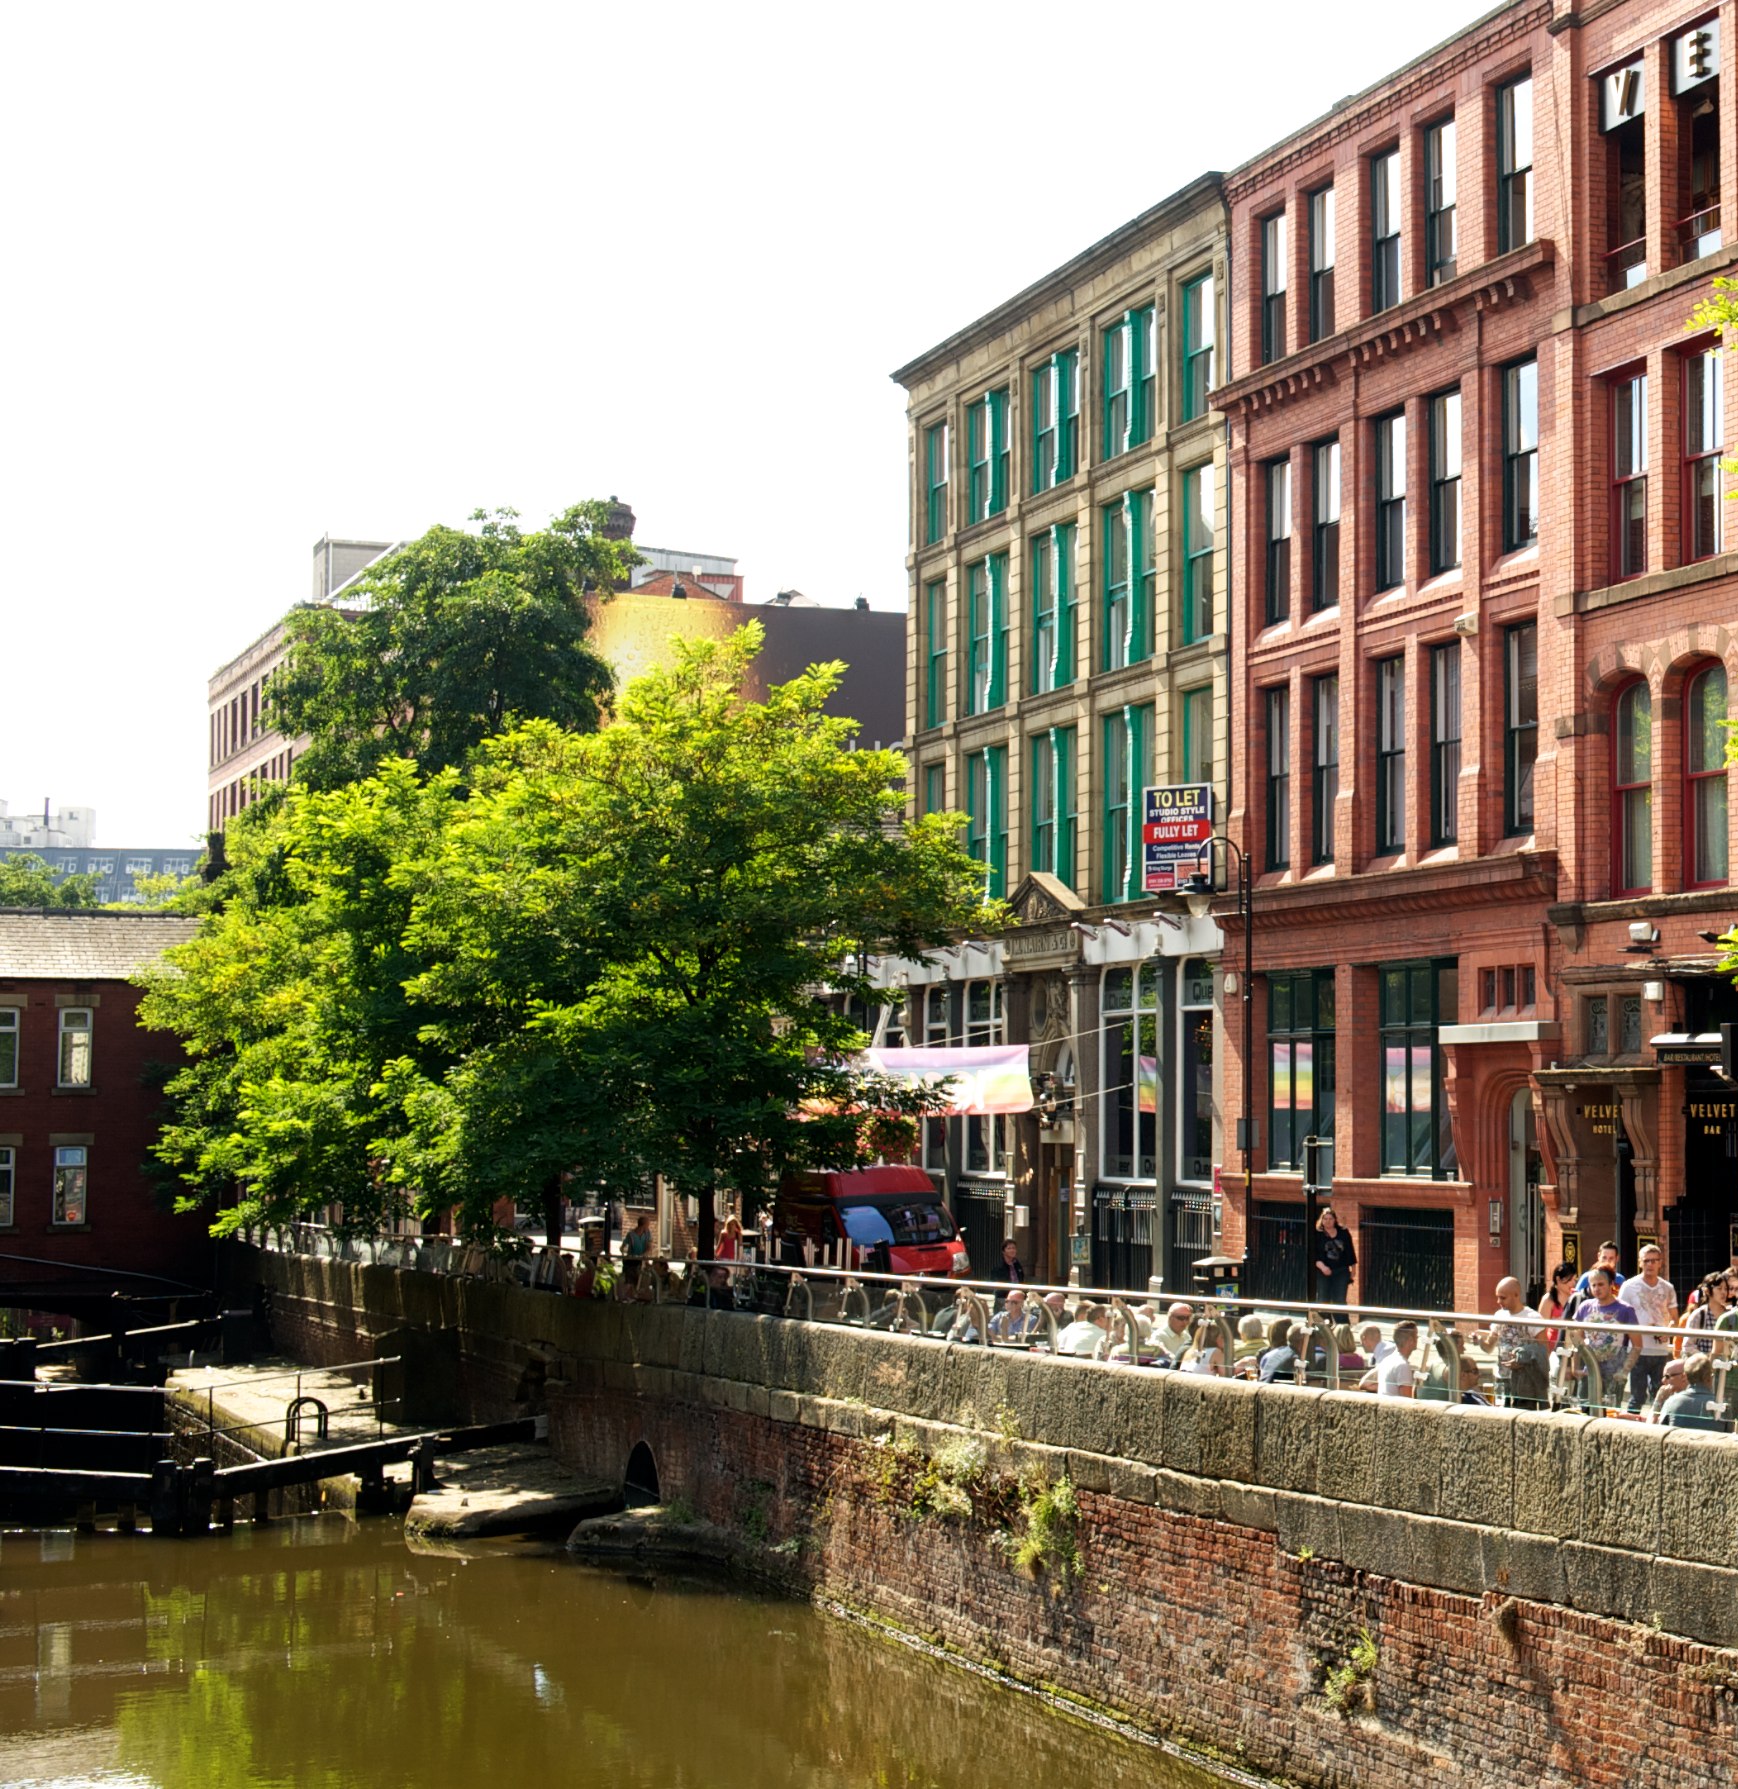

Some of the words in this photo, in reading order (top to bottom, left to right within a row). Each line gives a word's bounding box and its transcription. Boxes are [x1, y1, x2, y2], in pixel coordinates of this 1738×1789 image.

[1153, 791, 1172, 808] TO
[1175, 789, 1200, 806] LET
[1149, 808, 1179, 817] STUDIO
[1181, 806, 1205, 815] STYLE
[1153, 825, 1180, 839] FULLY
[1182, 824, 1199, 837] LET
[1690, 1103, 1736, 1119] VELVET
[1592, 1124, 1617, 1135] HOTEL
[1703, 1125, 1721, 1135] BAR
